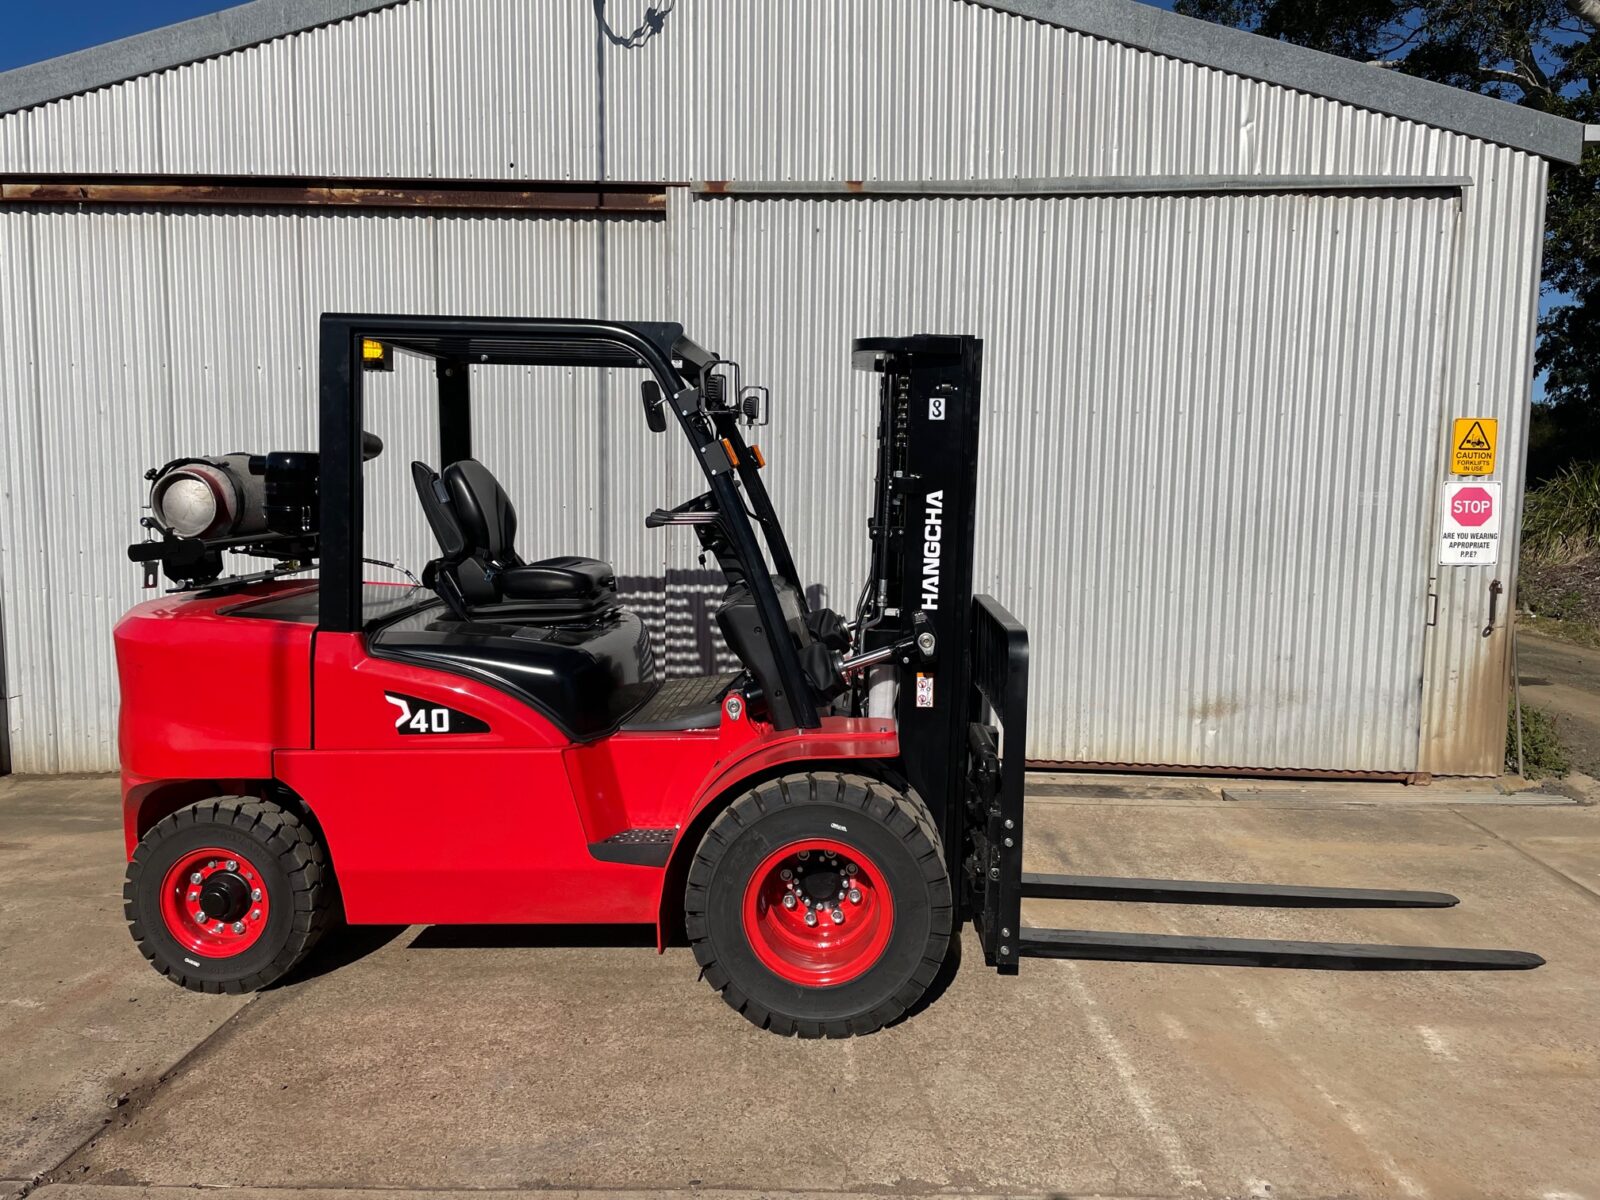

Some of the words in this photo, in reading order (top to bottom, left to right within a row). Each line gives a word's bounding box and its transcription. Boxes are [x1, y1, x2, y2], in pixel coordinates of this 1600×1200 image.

[1453, 500, 1491, 514] STOP
[921, 489, 944, 610] HANGCHA
[1449, 541, 1490, 549] APPROPRIATE
